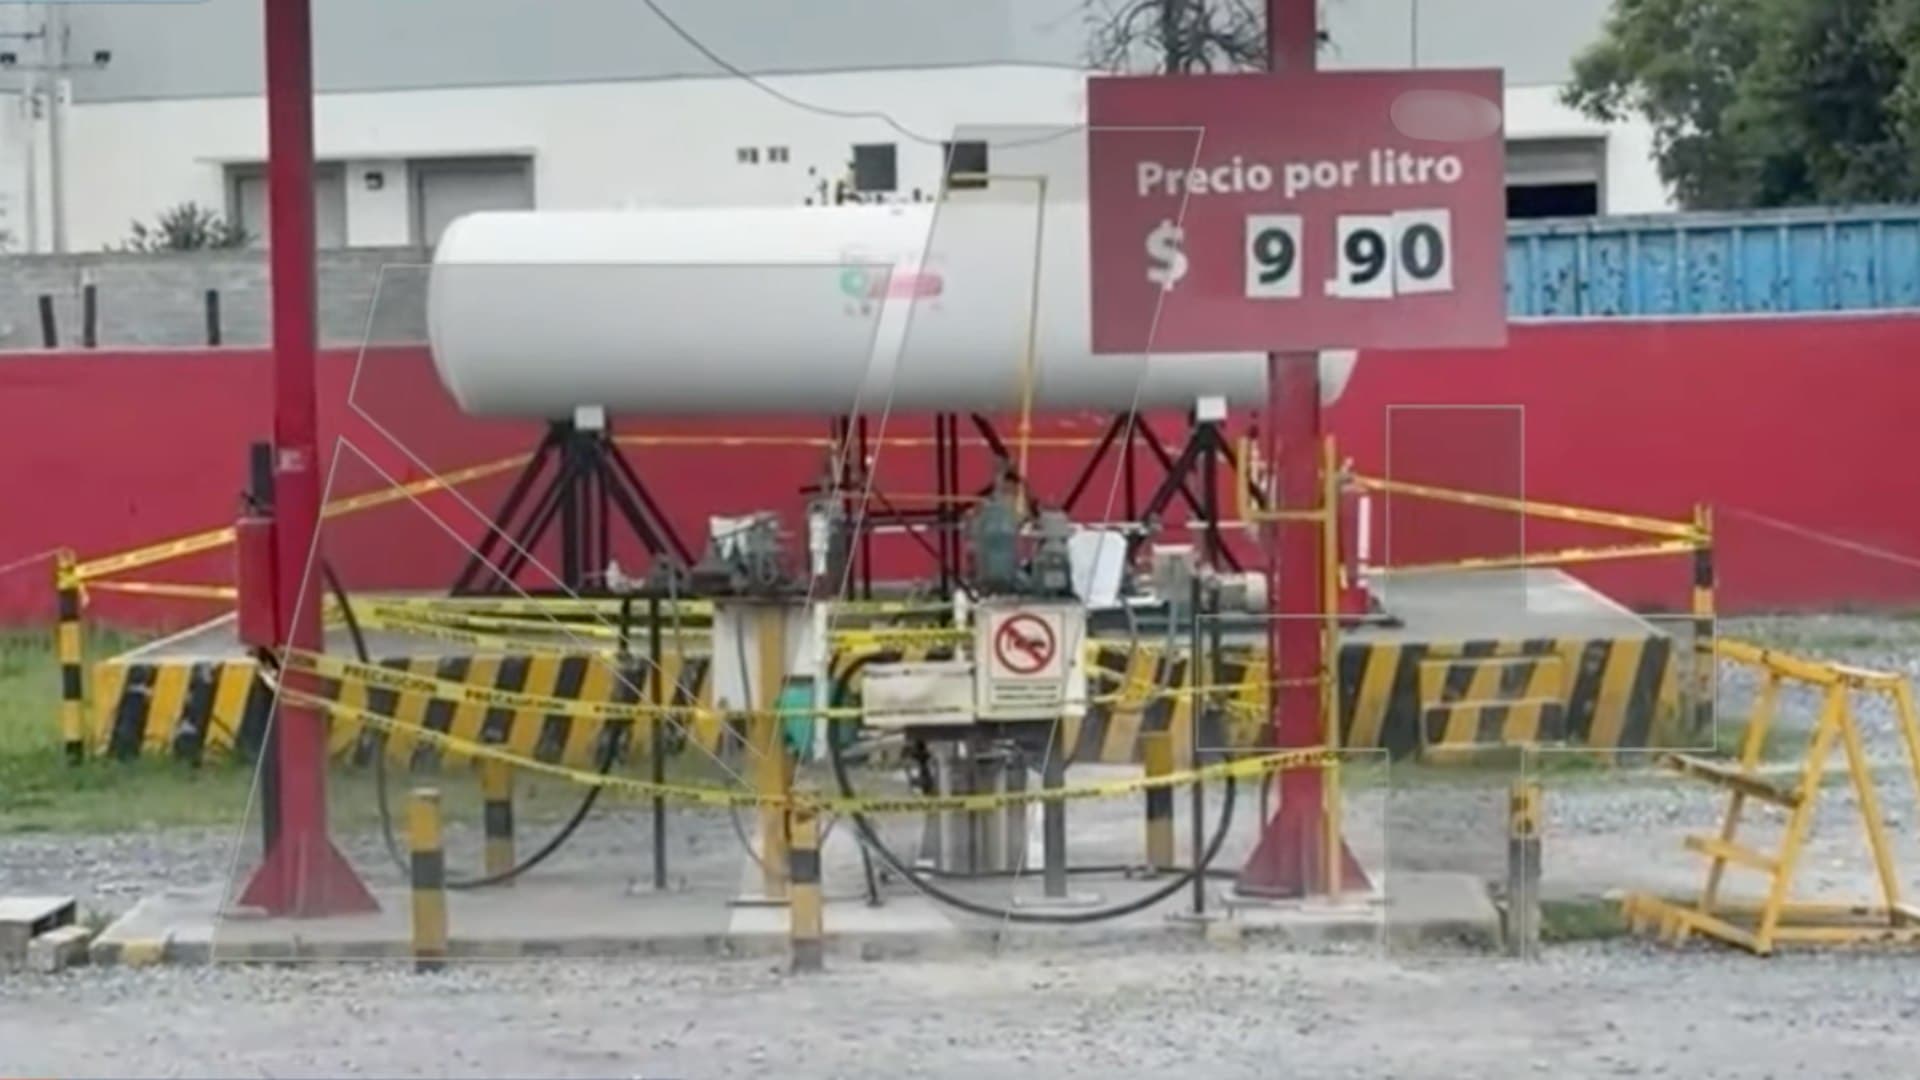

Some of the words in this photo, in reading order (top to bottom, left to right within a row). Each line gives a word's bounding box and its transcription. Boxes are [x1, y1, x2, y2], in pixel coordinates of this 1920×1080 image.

[1138, 157, 1271, 196] Precio
[1285, 160, 1359, 198] por
[1370, 149, 1462, 185] litro
[1146, 219, 1188, 291] $
